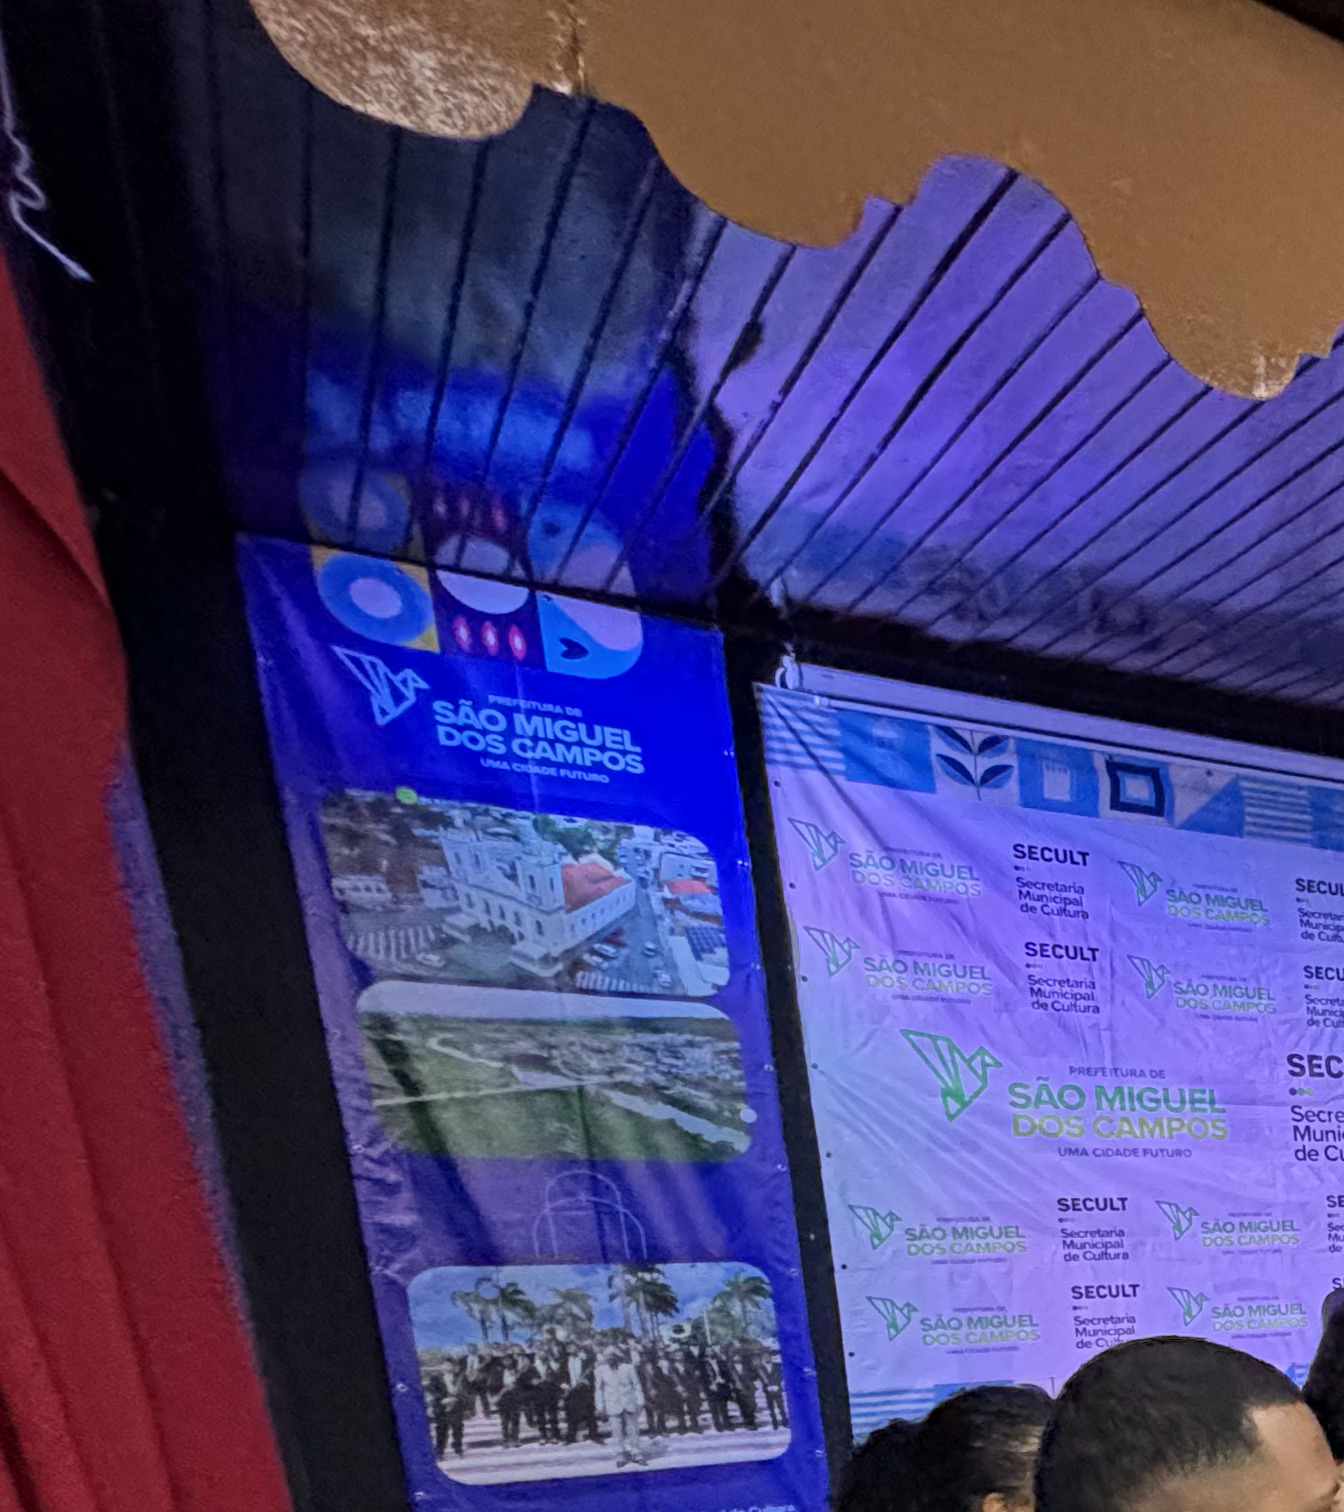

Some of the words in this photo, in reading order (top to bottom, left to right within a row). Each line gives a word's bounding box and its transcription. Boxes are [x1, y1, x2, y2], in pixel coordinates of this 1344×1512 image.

[432, 698, 507, 732] SÃO
[513, 712, 642, 753] MIGUEL
[436, 724, 507, 755] DOS
[511, 737, 645, 774] CAMPOS
[1012, 843, 1090, 867] SECULT
[849, 850, 896, 871] SÃO
[899, 858, 980, 881] MIGUEL
[851, 870, 895, 887] DOS
[900, 875, 982, 897] CAMPOS
[1015, 876, 1085, 895] Secretaria
[1018, 889, 1084, 908] Municipal
[1205, 893, 1268, 912] MIGUEL
[1019, 903, 1038, 915] de
[1040, 903, 1090, 920] Cultura
[1167, 905, 1201, 919] DOS
[1205, 908, 1270, 926] CAMPOS
[1301, 930, 1315, 941] de
[1024, 941, 1100, 962] SECULT
[863, 953, 909, 975] SÃO
[913, 960, 992, 981] MIGUEL
[865, 974, 908, 990] DOS
[912, 977, 993, 996] CAMPOS
[1027, 974, 1096, 990] Secretaria
[1029, 986, 1095, 1003] Municipal
[1212, 984, 1276, 1001] MIGUEL
[1031, 1000, 1049, 1011] de
[1051, 1000, 1100, 1014] Cultura
[1175, 997, 1209, 1010] DOS
[1212, 999, 1276, 1014] CAMPOS
[1307, 1017, 1320, 1028] de
[1069, 1065, 1147, 1079] PREFEITURA
[1149, 1069, 1166, 1080] DE
[1008, 1075, 1087, 1111] SÃO
[1094, 1084, 1226, 1114] MIGUEL
[1012, 1114, 1086, 1139] DOS
[1092, 1115, 1229, 1141] CAMPOS
[1057, 1146, 1089, 1158] UMA
[1092, 1147, 1141, 1158] CIDADE
[1143, 1148, 1193, 1159] FUTURO
[1294, 1145, 1320, 1162] de
[1057, 1197, 1128, 1212] SECULT
[905, 1223, 948, 1242] SÃO
[951, 1225, 1026, 1240] MIGUEL
[1060, 1228, 1125, 1238] Secretaria
[1201, 1219, 1235, 1234] SÃO
[1238, 1219, 1300, 1233] MIGUEL
[907, 1243, 947, 1257] DOS
[950, 1240, 1028, 1255] CAMPOS
[1062, 1239, 1124, 1252] Municipal
[1202, 1236, 1234, 1248] DOS
[1237, 1234, 1300, 1246] CAMPOS
[1328, 1243, 1343, 1253] de
[1063, 1251, 1080, 1263] de
[1083, 1250, 1129, 1262] Cultura
[1071, 1284, 1140, 1300] SECULT
[1211, 1303, 1245, 1319] SÃO
[1248, 1303, 1306, 1317] MIGUEL
[920, 1313, 963, 1332] SÃO
[966, 1314, 1039, 1330] MIGUEL
[1073, 1313, 1136, 1327] Secretaria
[1212, 1320, 1244, 1332] DOS
[1247, 1317, 1308, 1330] CAMPOS
[922, 1332, 962, 1347] DOS
[965, 1329, 1040, 1345] CAMPOS
[1075, 1325, 1136, 1339] Municipal
[1076, 1338, 1093, 1350] de
